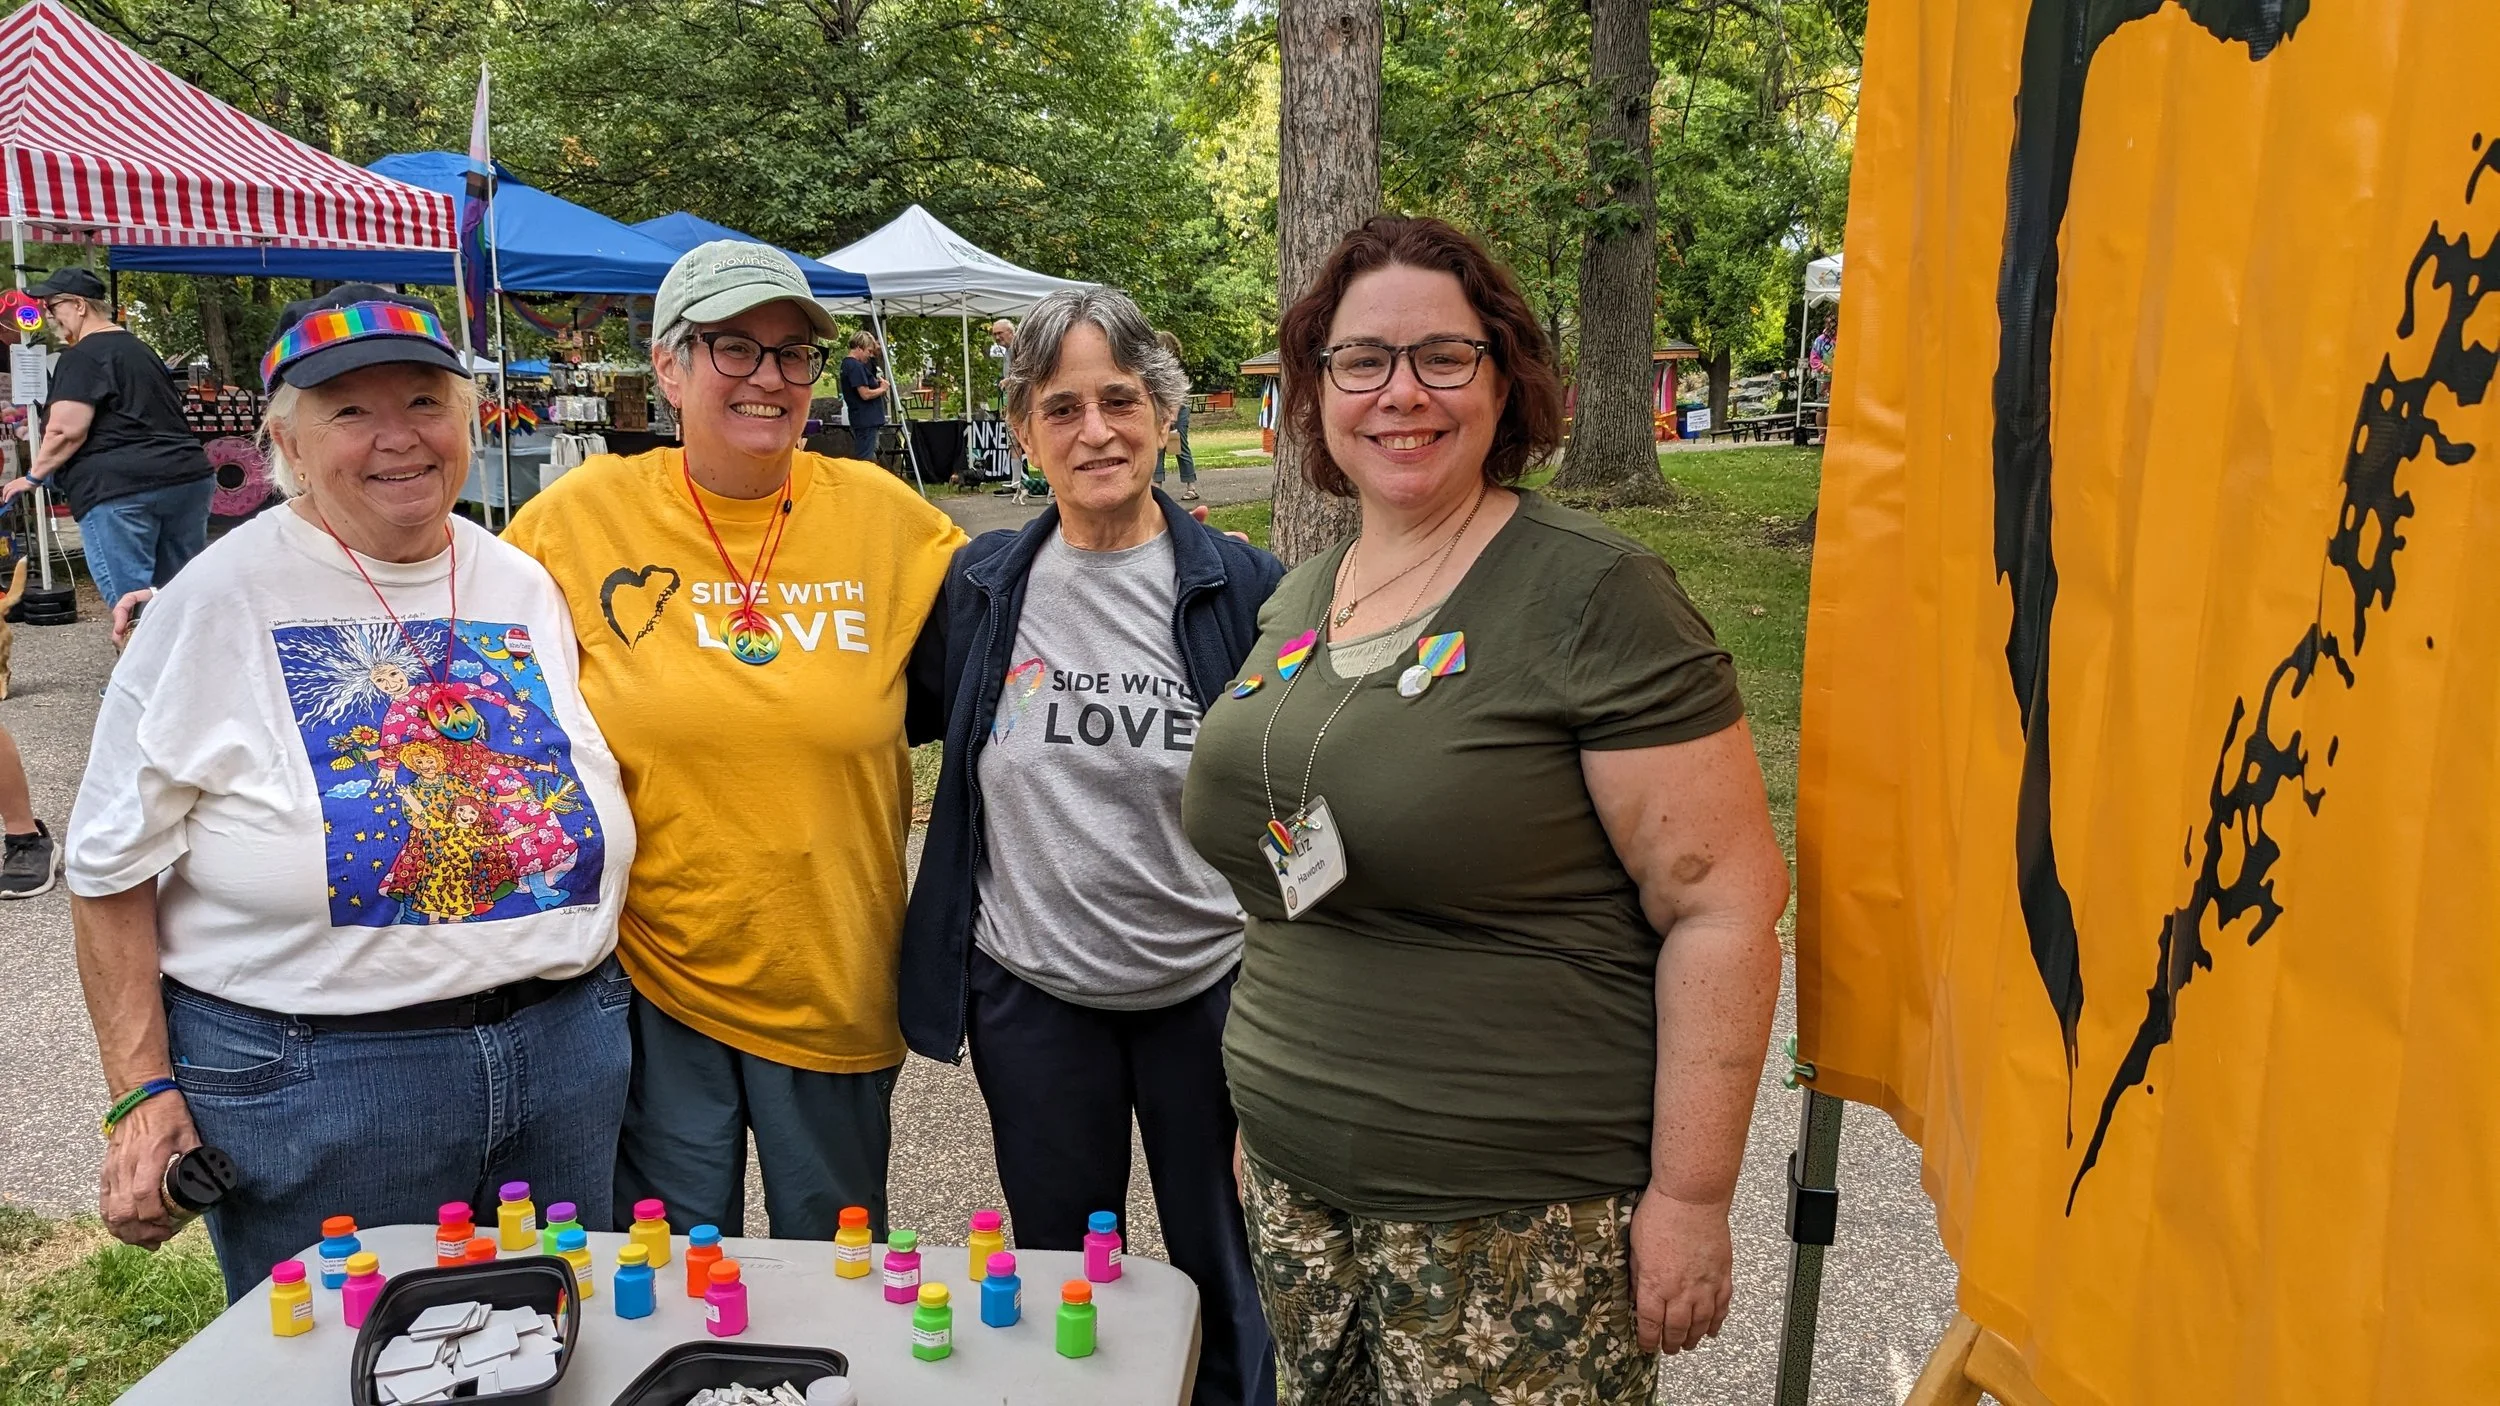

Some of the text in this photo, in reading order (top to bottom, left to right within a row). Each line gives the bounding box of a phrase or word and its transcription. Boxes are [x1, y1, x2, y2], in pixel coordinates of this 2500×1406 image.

[691, 580, 864, 605] SIDE WITH
[1052, 670, 1110, 694] SIDE
[1044, 703, 1194, 751] LOVE
[1297, 859, 1326, 884] Haworth
